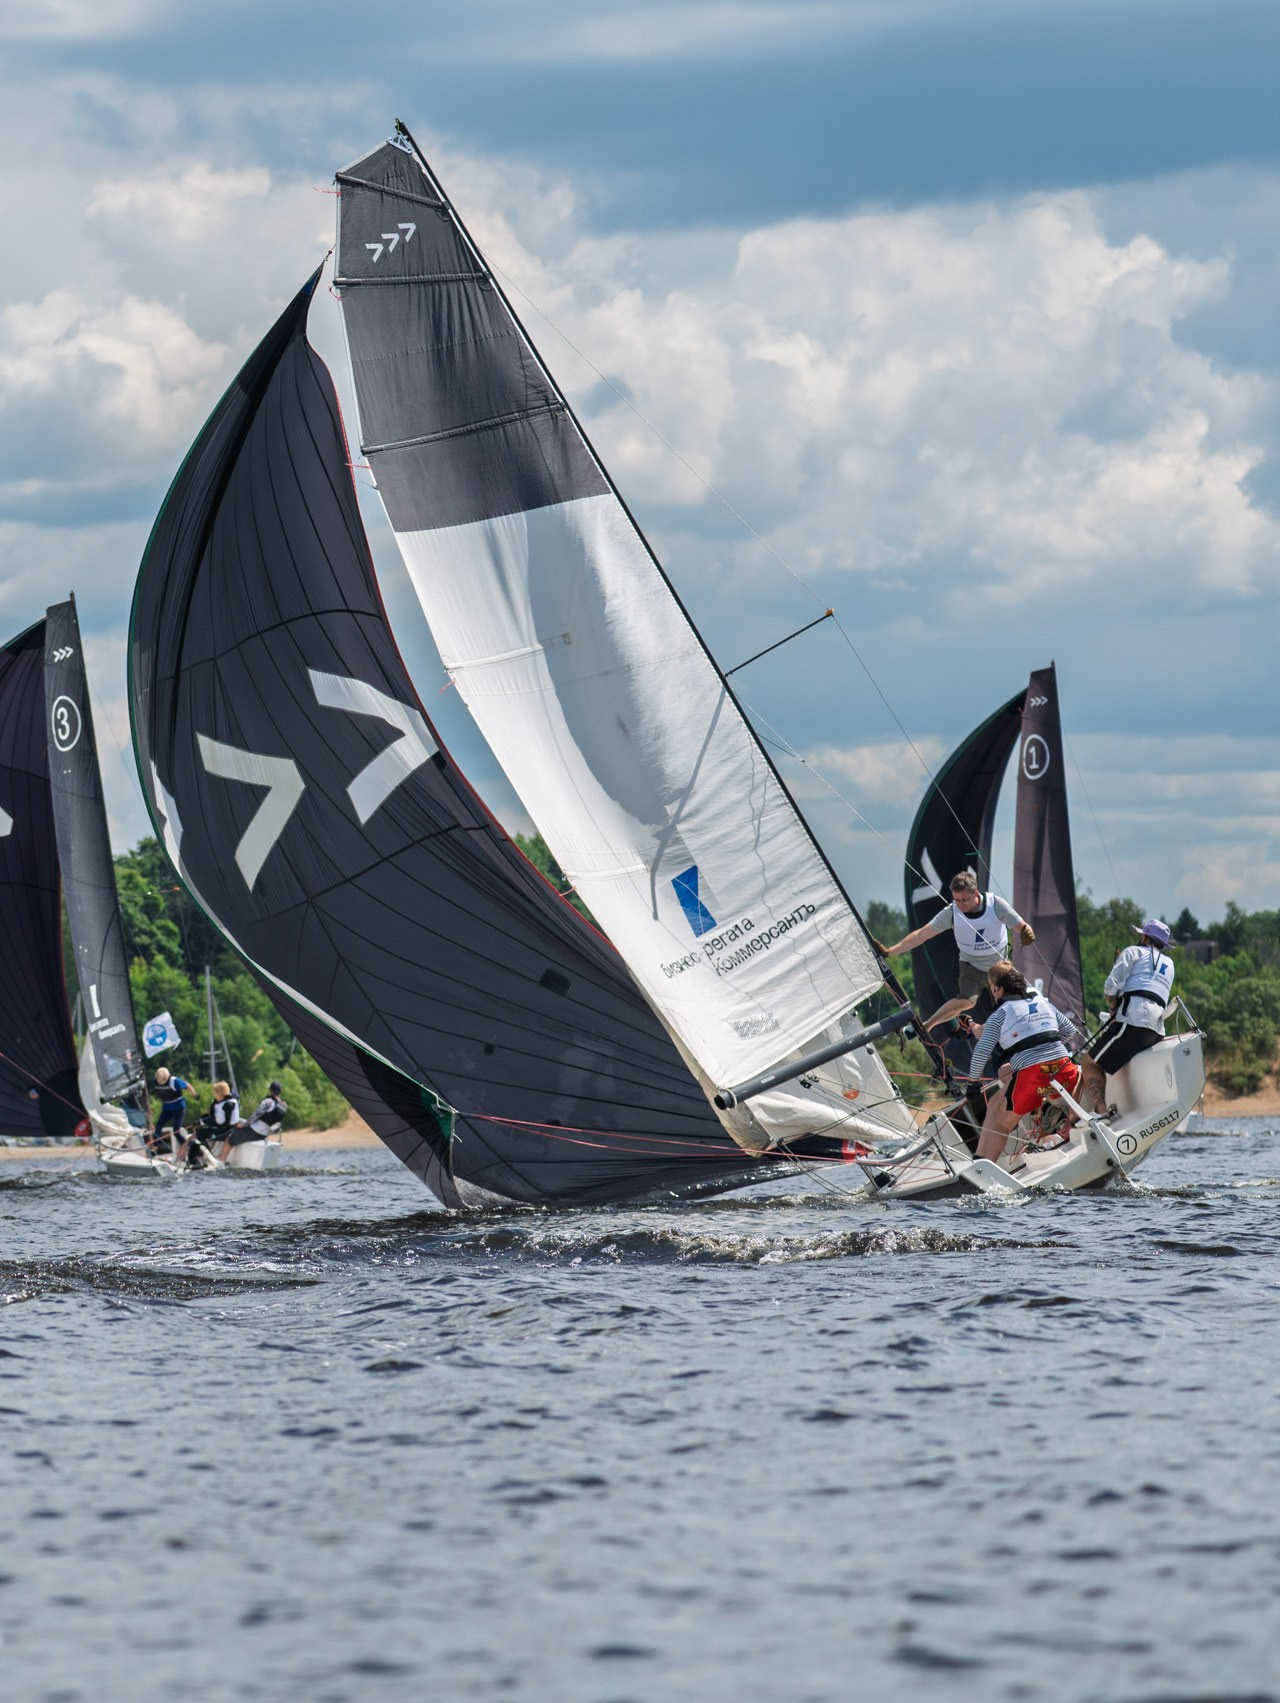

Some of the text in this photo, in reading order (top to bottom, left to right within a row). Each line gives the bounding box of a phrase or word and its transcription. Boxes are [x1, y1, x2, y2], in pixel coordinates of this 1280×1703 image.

[57, 706, 70, 740] 3
[1028, 745, 1039, 770] 1
[1139, 1110, 1180, 1139] RUS6117
[1121, 1138, 1130, 1151] 7
